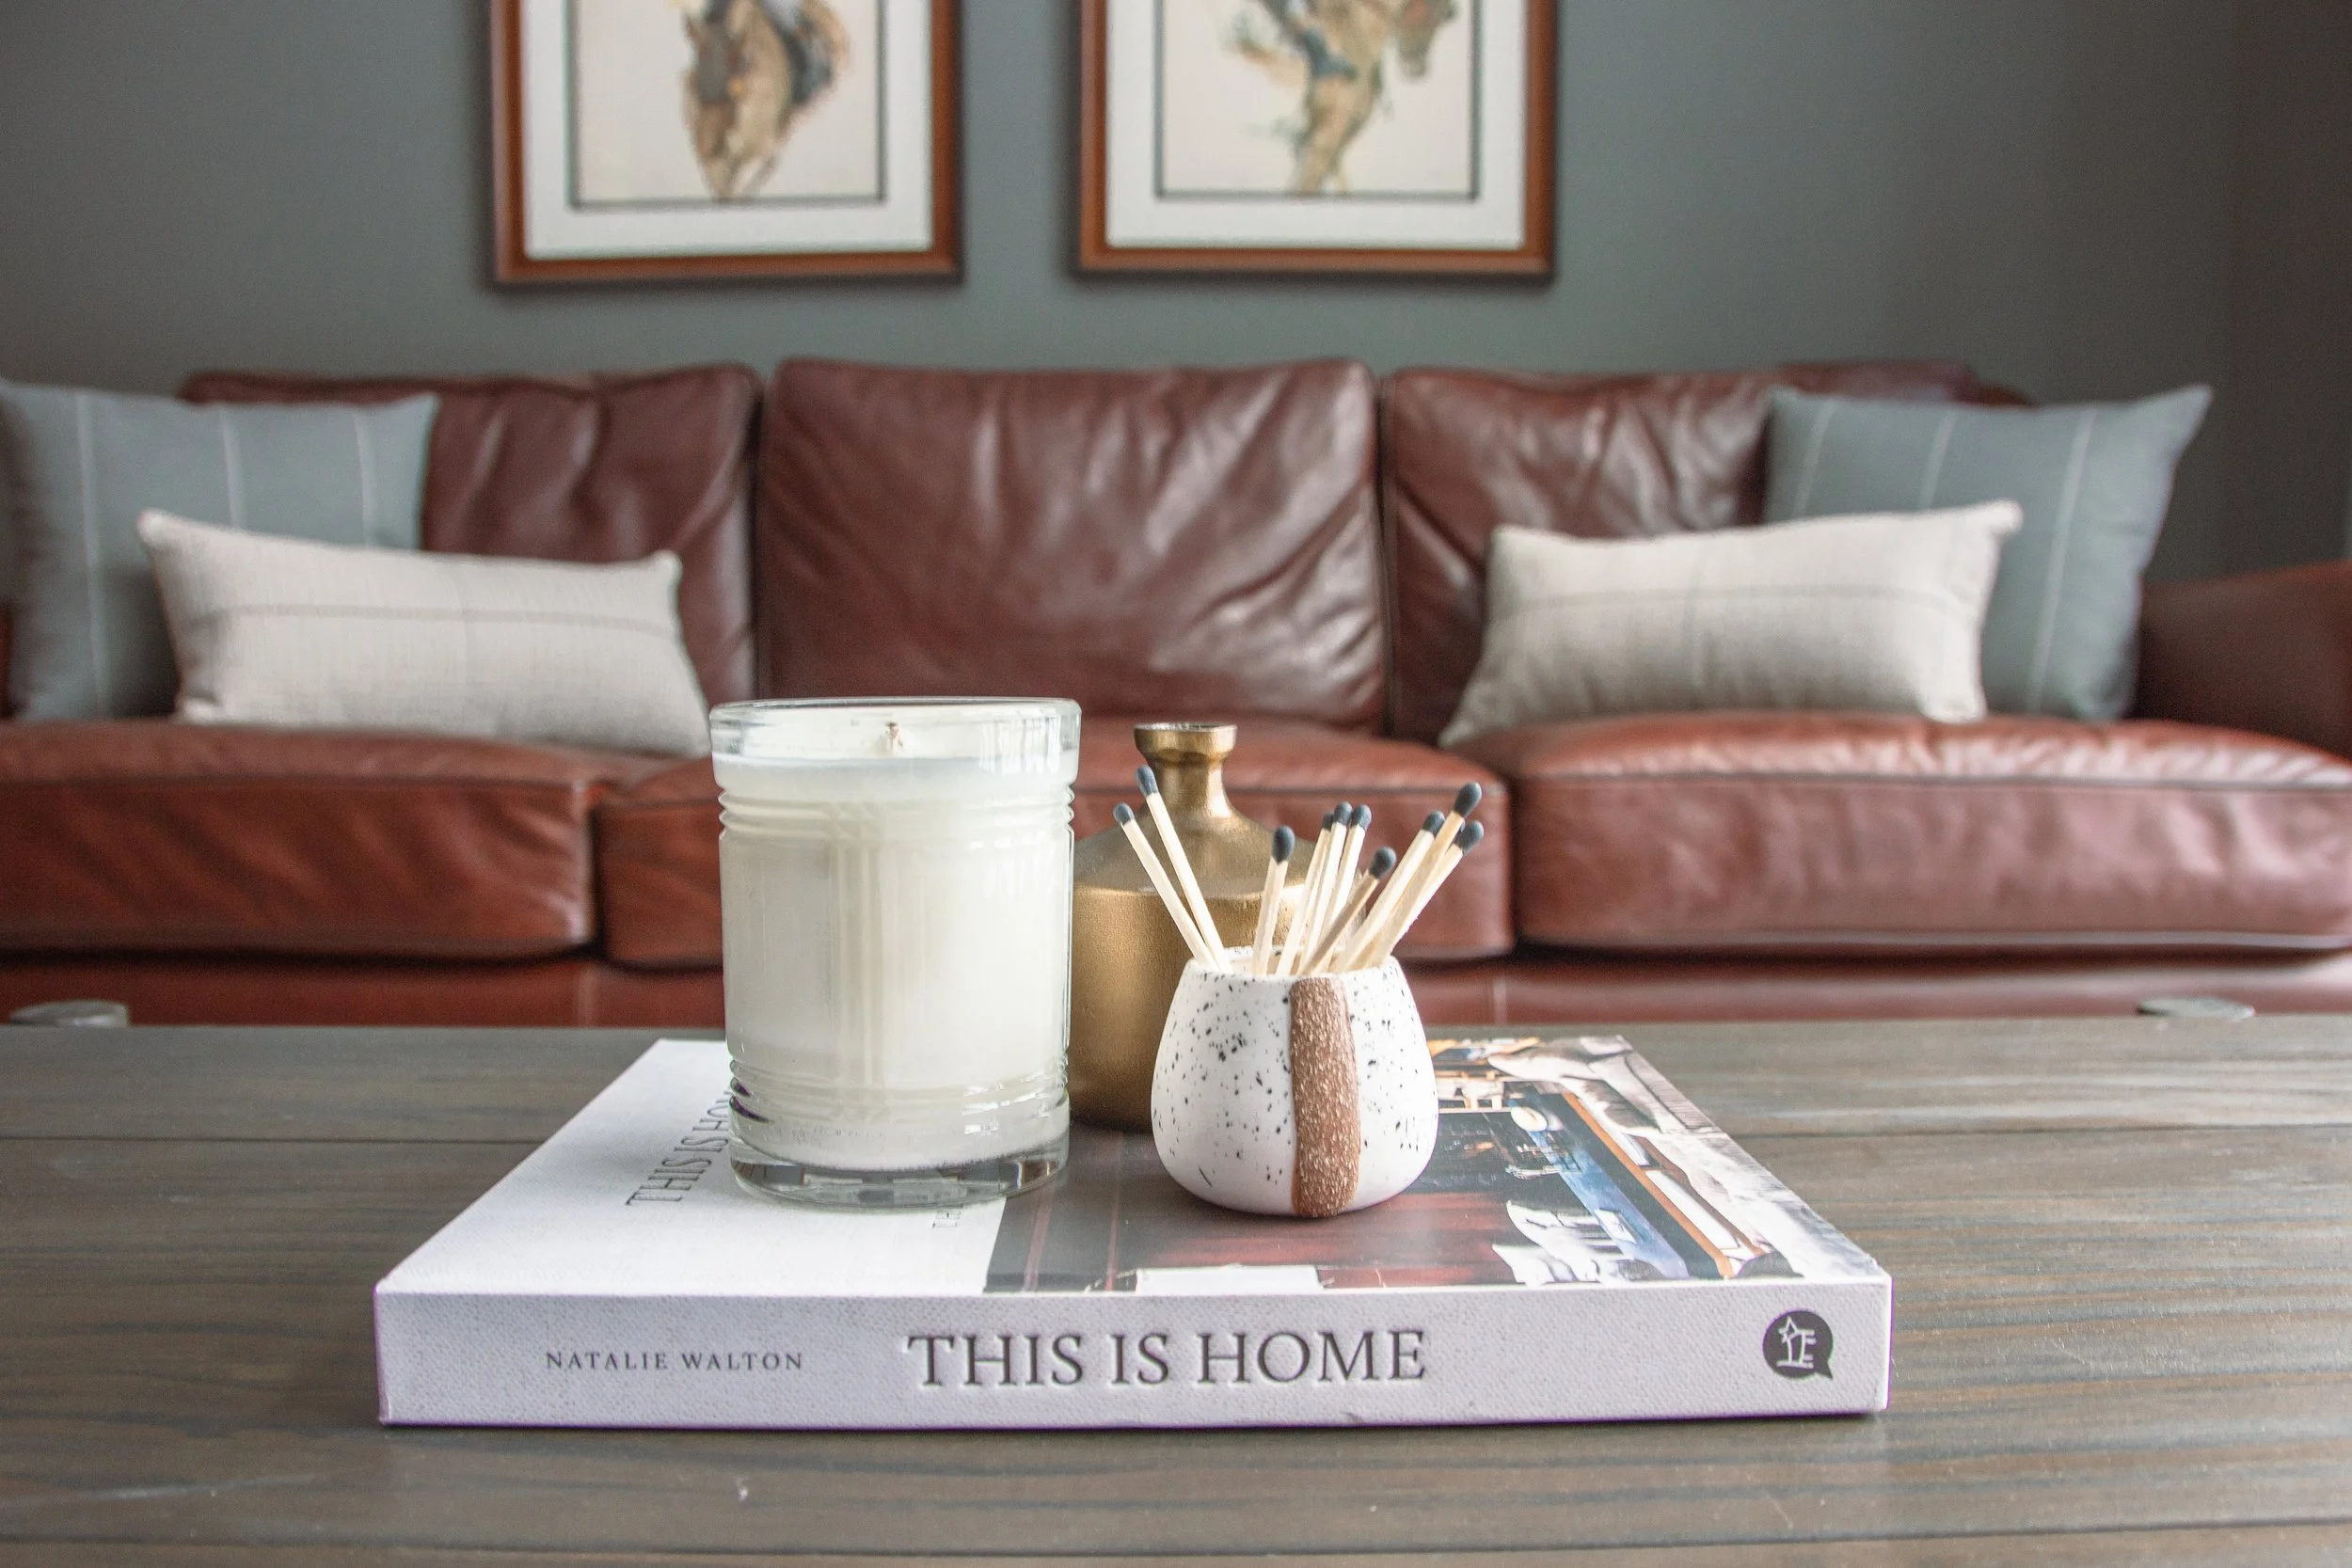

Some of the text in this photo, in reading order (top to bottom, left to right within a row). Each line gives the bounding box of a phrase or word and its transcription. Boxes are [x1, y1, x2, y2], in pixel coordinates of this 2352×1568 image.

[626, 1159, 712, 1205] THIS
[674, 1136, 729, 1152] IS
[546, 1351, 803, 1370] NATALIE WALTON
[907, 1329, 1425, 1386] THIS IS HOME
